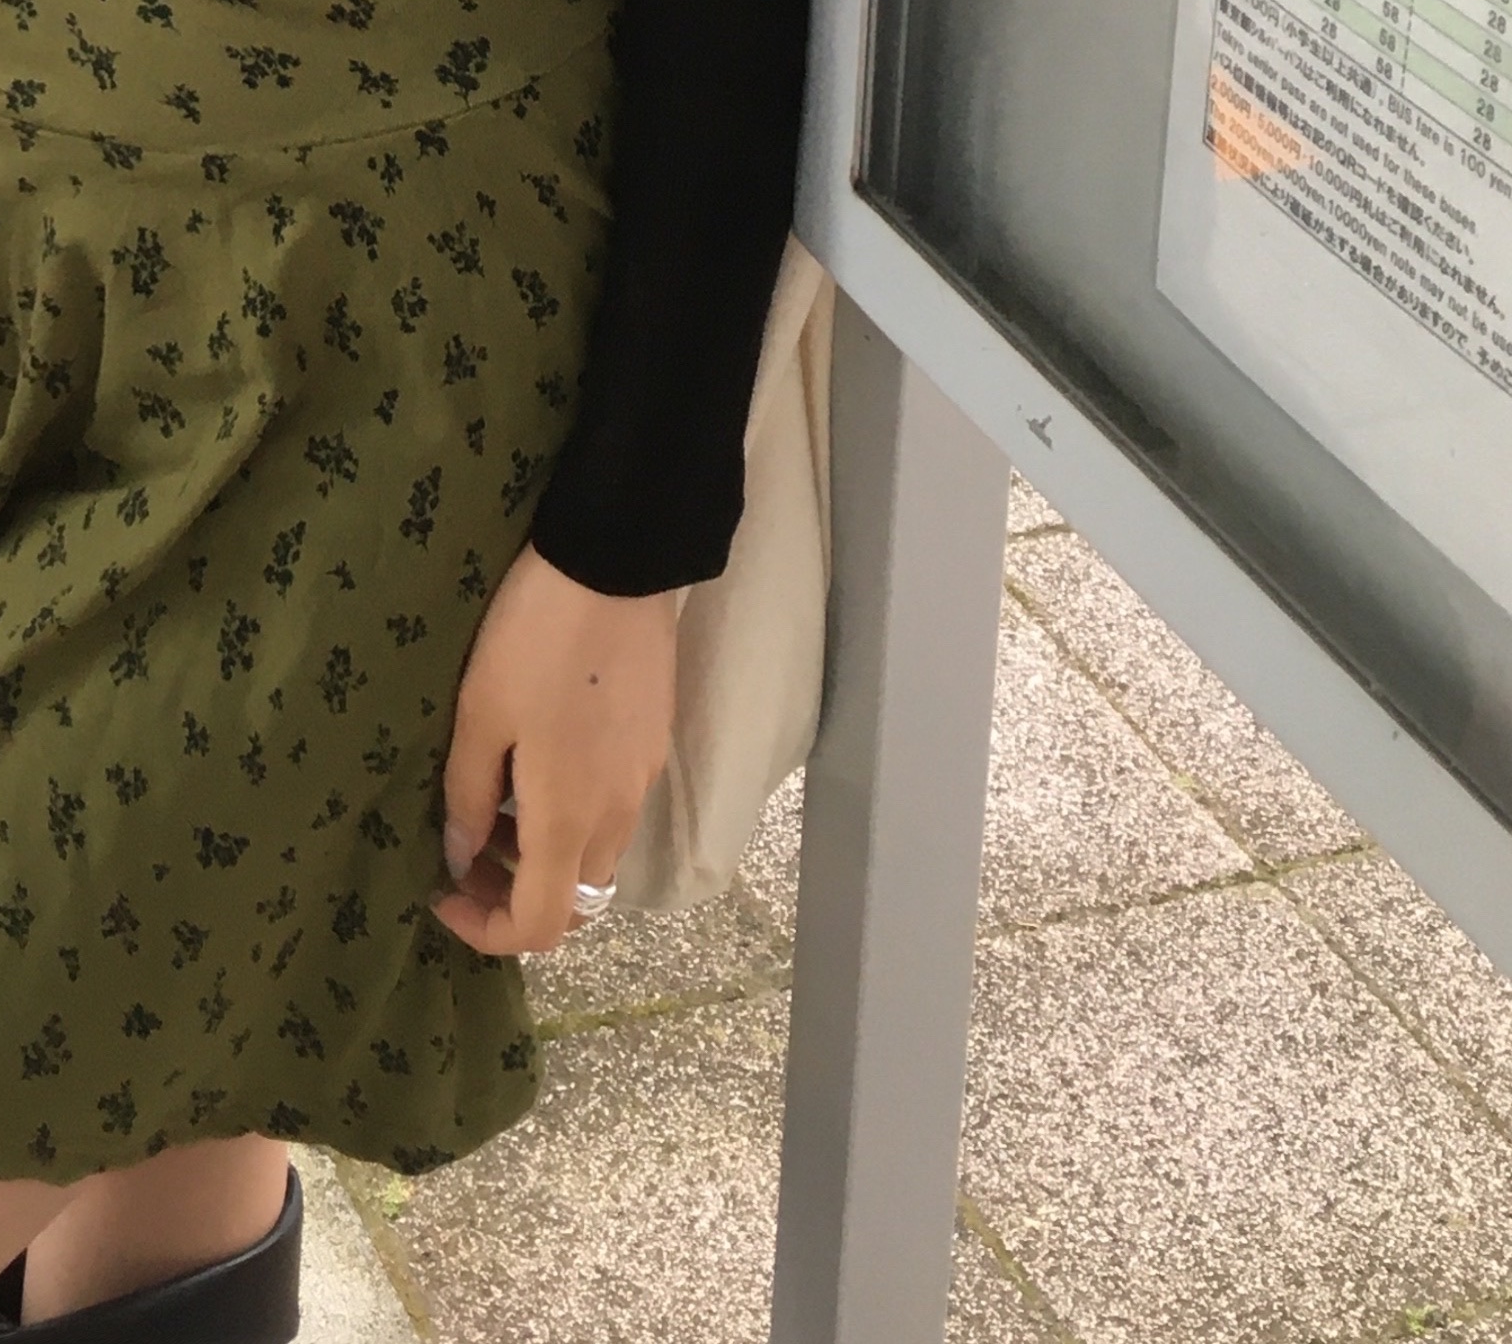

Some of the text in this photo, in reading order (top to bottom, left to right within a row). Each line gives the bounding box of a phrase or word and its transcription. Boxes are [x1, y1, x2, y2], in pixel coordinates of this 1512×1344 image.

[1488, 10, 1506, 34] 28
[1484, 39, 1502, 63] 28
[1321, 17, 1337, 39] 28
[1473, 127, 1491, 151] 28
[1481, 69, 1498, 93] 28
[1477, 97, 1494, 122] 28
[1387, 92, 1412, 128] BUS
[1460, 145, 1485, 183] 100
[1489, 169, 1511, 204] yen
